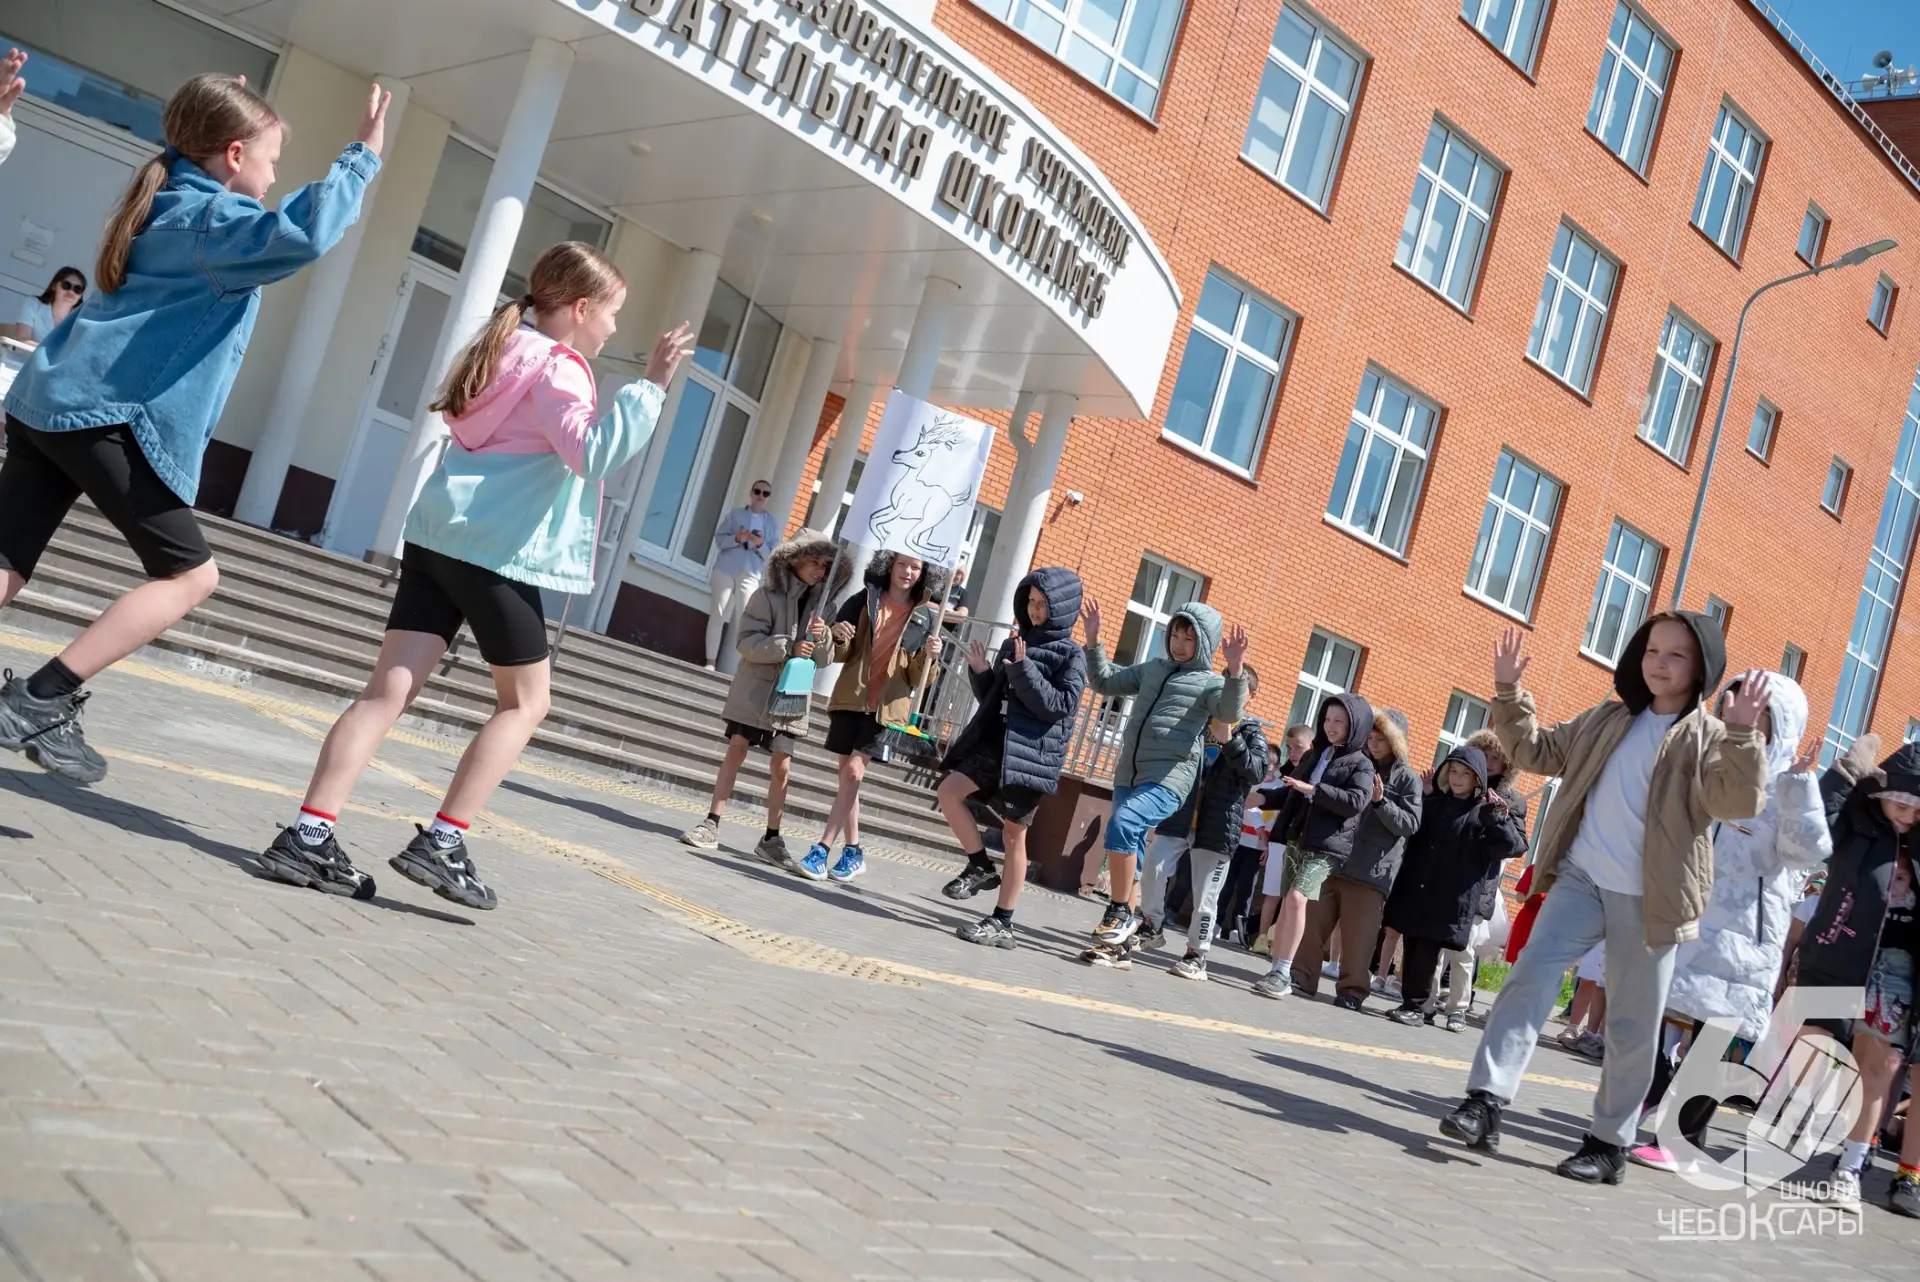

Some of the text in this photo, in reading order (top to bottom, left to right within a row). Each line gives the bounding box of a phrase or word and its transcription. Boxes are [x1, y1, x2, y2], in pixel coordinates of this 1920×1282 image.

[783, 0, 1016, 156] ЗОВАТЕЛЬНОЕ
[298, 823, 329, 840] PUMA
[1199, 916, 1211, 941] GOOD
[1212, 860, 1225, 882] ONLY
